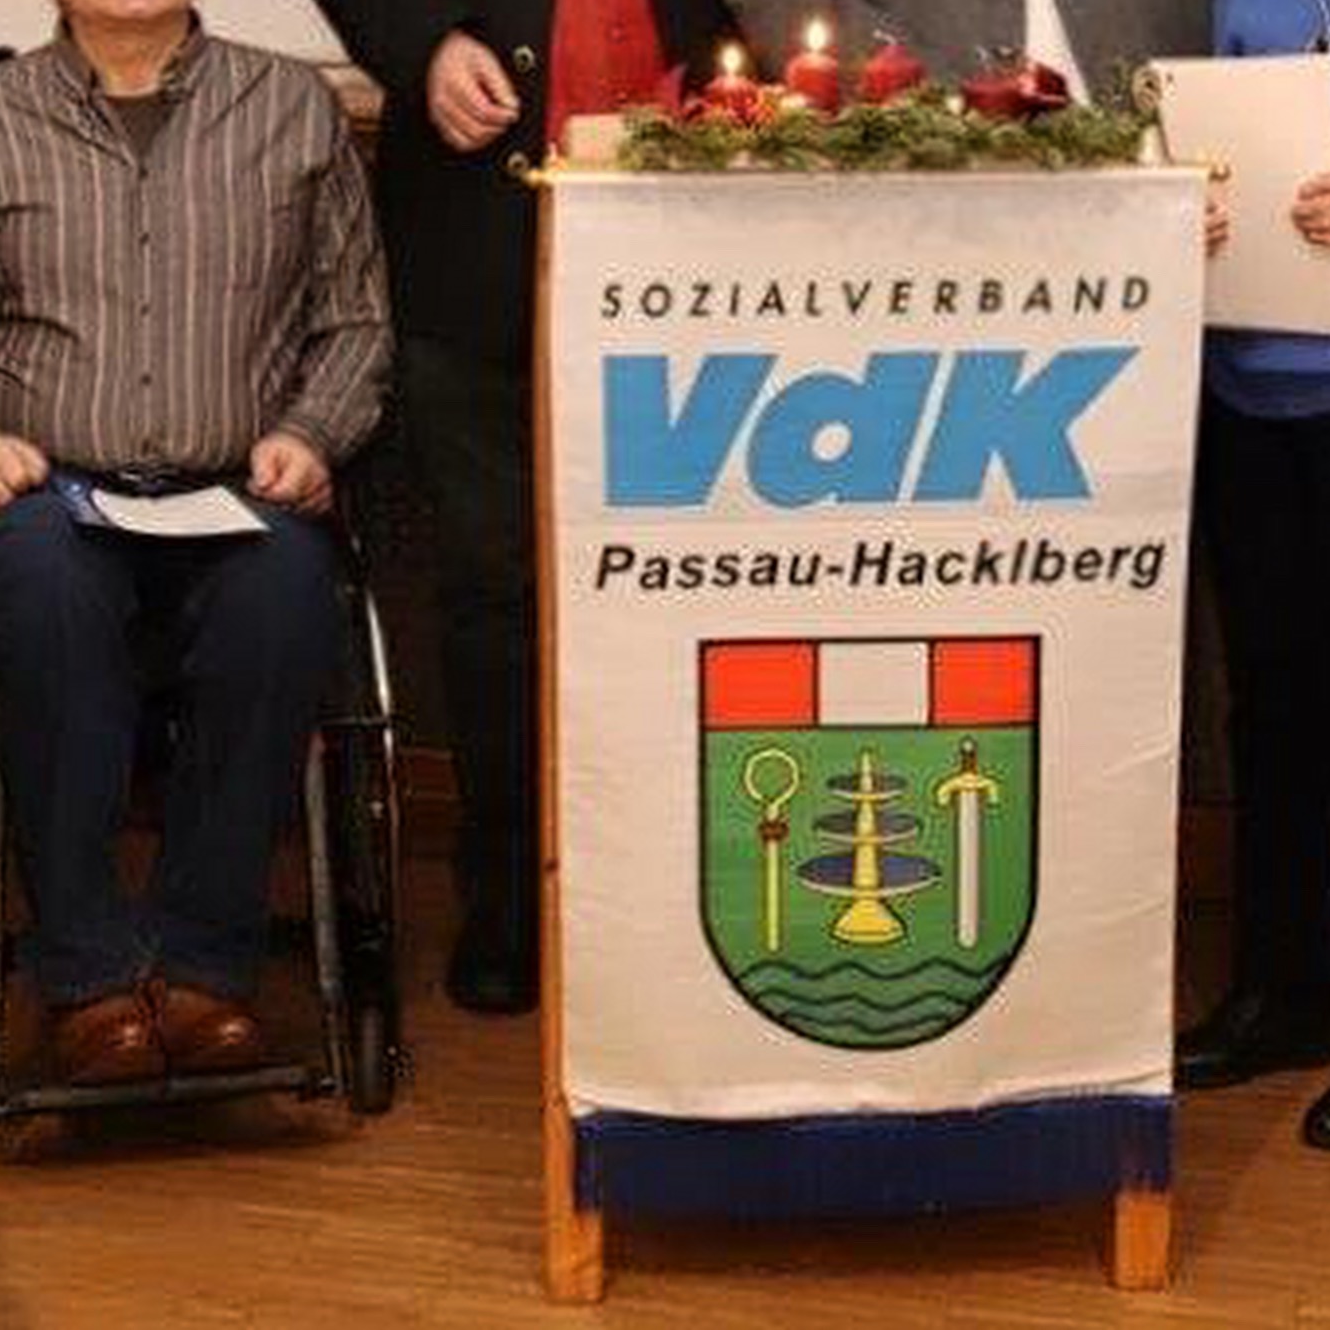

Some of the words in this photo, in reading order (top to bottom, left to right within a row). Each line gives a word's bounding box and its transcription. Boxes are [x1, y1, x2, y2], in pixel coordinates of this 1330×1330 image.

[601, 276, 1152, 318] SOZIALVERBAND
[602, 346, 1141, 508] VdK
[595, 540, 1165, 590] Passau-Hacklberg
